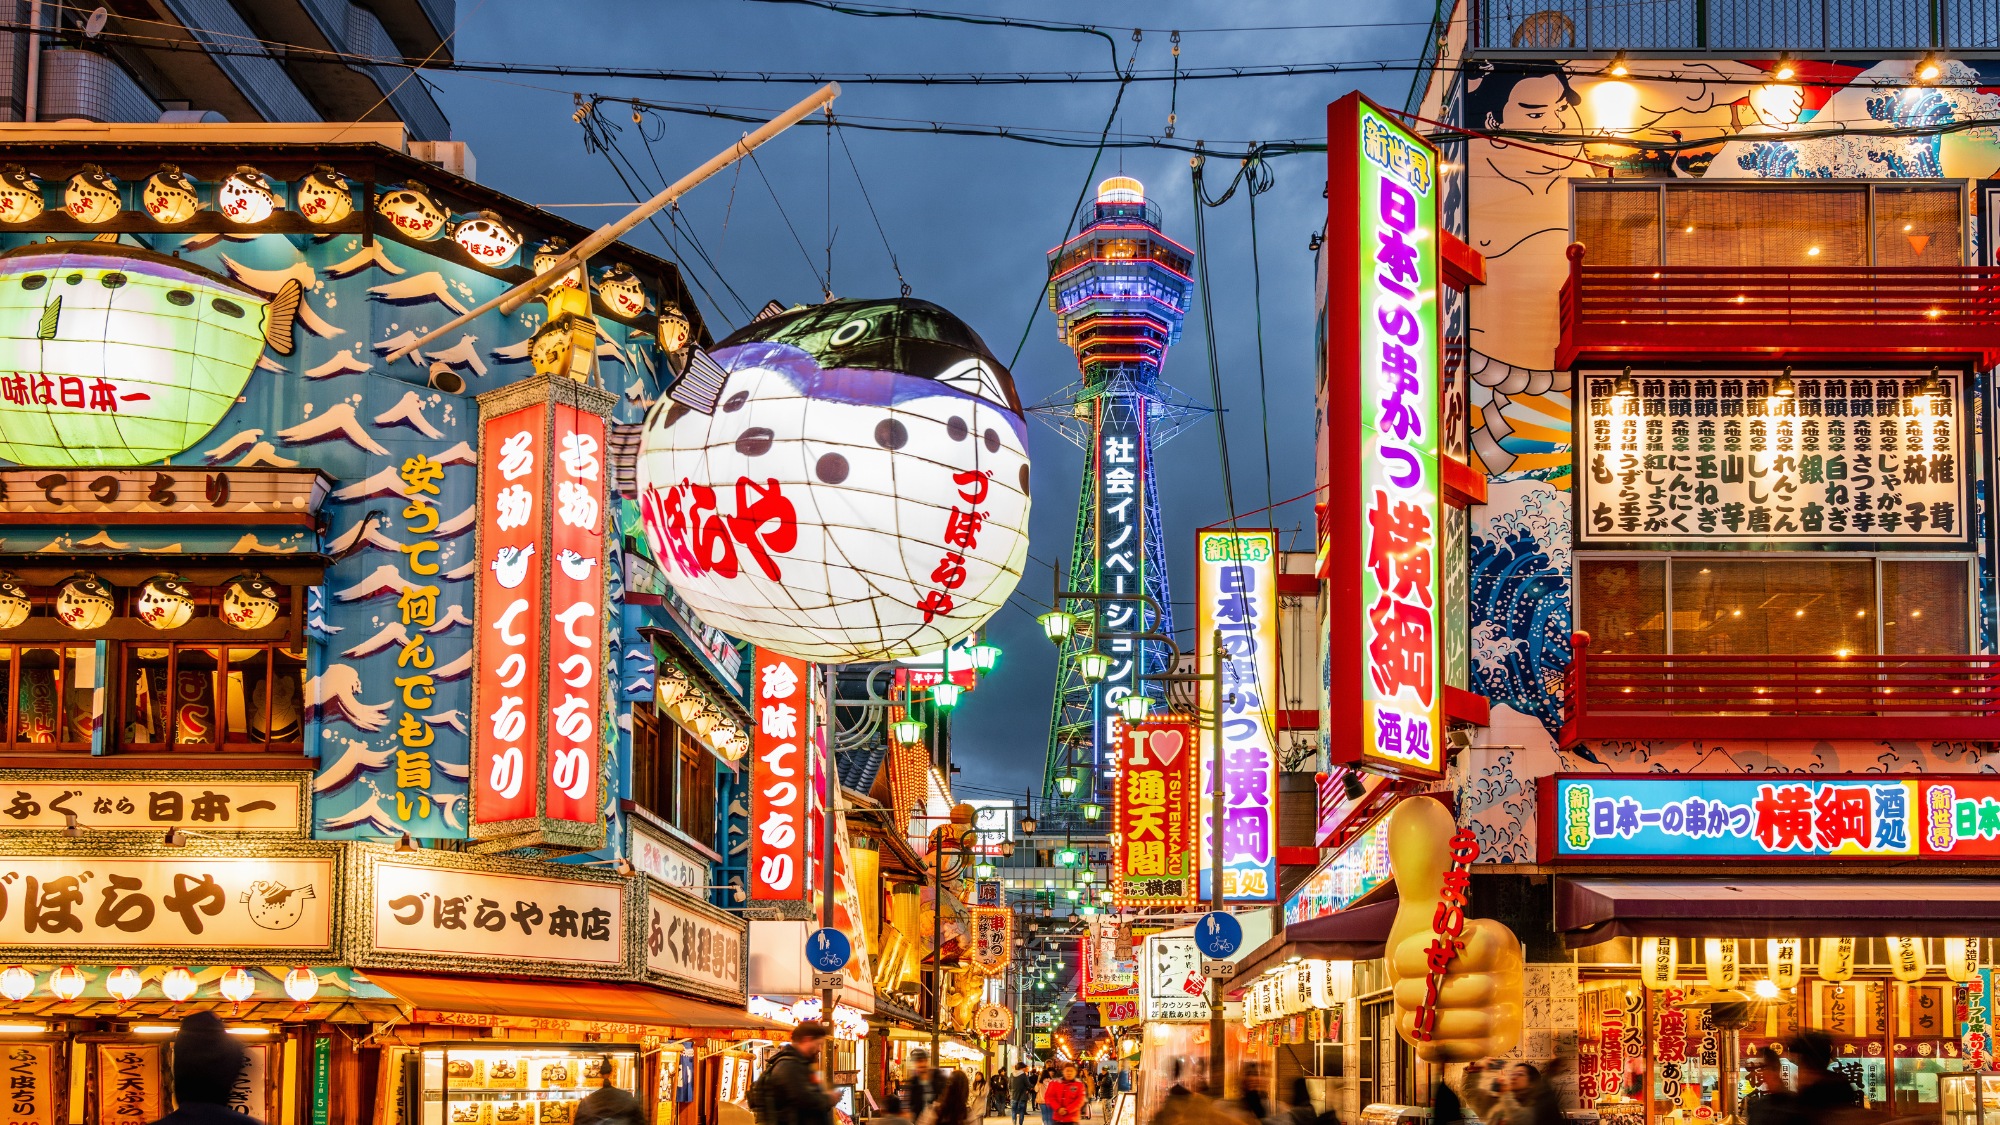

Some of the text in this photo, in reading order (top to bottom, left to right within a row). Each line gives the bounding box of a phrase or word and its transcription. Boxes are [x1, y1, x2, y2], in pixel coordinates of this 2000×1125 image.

[1364, 114, 1430, 193] 新世界
[1377, 174, 1423, 490] 日本一の串かつ
[0, 371, 151, 412] 味は日本一
[1590, 379, 1613, 418] 前頭
[1642, 379, 1666, 418] 前頭
[1668, 379, 1692, 418] 前頭
[1694, 379, 1718, 418] 前頭
[1720, 379, 1744, 418] 前頭
[1746, 379, 1770, 418] 前頭
[1797, 379, 1822, 418] 前頭
[1824, 379, 1848, 418] 前頭
[1850, 379, 1874, 418] 前頭
[1876, 379, 1900, 418] 前頭
[1902, 379, 1926, 418] 前頭
[1591, 453, 1614, 533] もち
[1617, 453, 1642, 533] うずら玉子
[1643, 453, 1668, 533] 紅しょうが
[1668, 453, 1693, 533] にんにく
[1694, 453, 1720, 533] 玉ねぎ
[1720, 453, 1745, 533] 山芋
[1746, 453, 1772, 533] しし唐
[1772, 453, 1798, 533] れんこん
[1797, 453, 1825, 533] 銀杏
[1824, 453, 1851, 533] 白ねぎ
[1850, 453, 1876, 533] さつま芋
[1877, 453, 1903, 533] じゃが芋
[1903, 453, 1929, 533] 茄子
[1928, 453, 1955, 533] 椎茸
[916, 469, 995, 624] づぼらや
[1205, 536, 1270, 563] 新世界
[1368, 489, 1434, 708] 横綱
[1128, 730, 1150, 766] I
[1377, 708, 1430, 760] 酒処
[3, 790, 277, 823] ふぐなら日本一
[758, 661, 799, 891] 珍味てっちり
[1205, 747, 1270, 865] 横綱
[1127, 769, 1167, 876] 通天閣
[1169, 769, 1182, 875] TSUTENKAKU
[1569, 787, 1907, 850] 新世界 日本一の串かつ 横綱 酒処
[1930, 788, 1953, 848] 新世界
[0, 871, 226, 935] ぼらや
[388, 891, 612, 942] づぼらや本店
[1145, 879, 1183, 897] 横綱
[648, 907, 738, 983] ふぐ料理専門
[990, 914, 1006, 956] 串かつ
[1779, 946, 1793, 976] 寿司
[1965, 937, 1978, 973] お造り
[1107, 1000, 1139, 1021] 299
[1624, 996, 1643, 1055] ソースの
[1831, 989, 1846, 1033] にんにく
[1918, 994, 1934, 1029] もち
[8, 1048, 38, 1116] ふぐ皮ちり
[1600, 1009, 1623, 1093] 二度漬け
[116, 1051, 145, 1117] ふぐ天ぷら
[317, 1099, 324, 1107] 5
